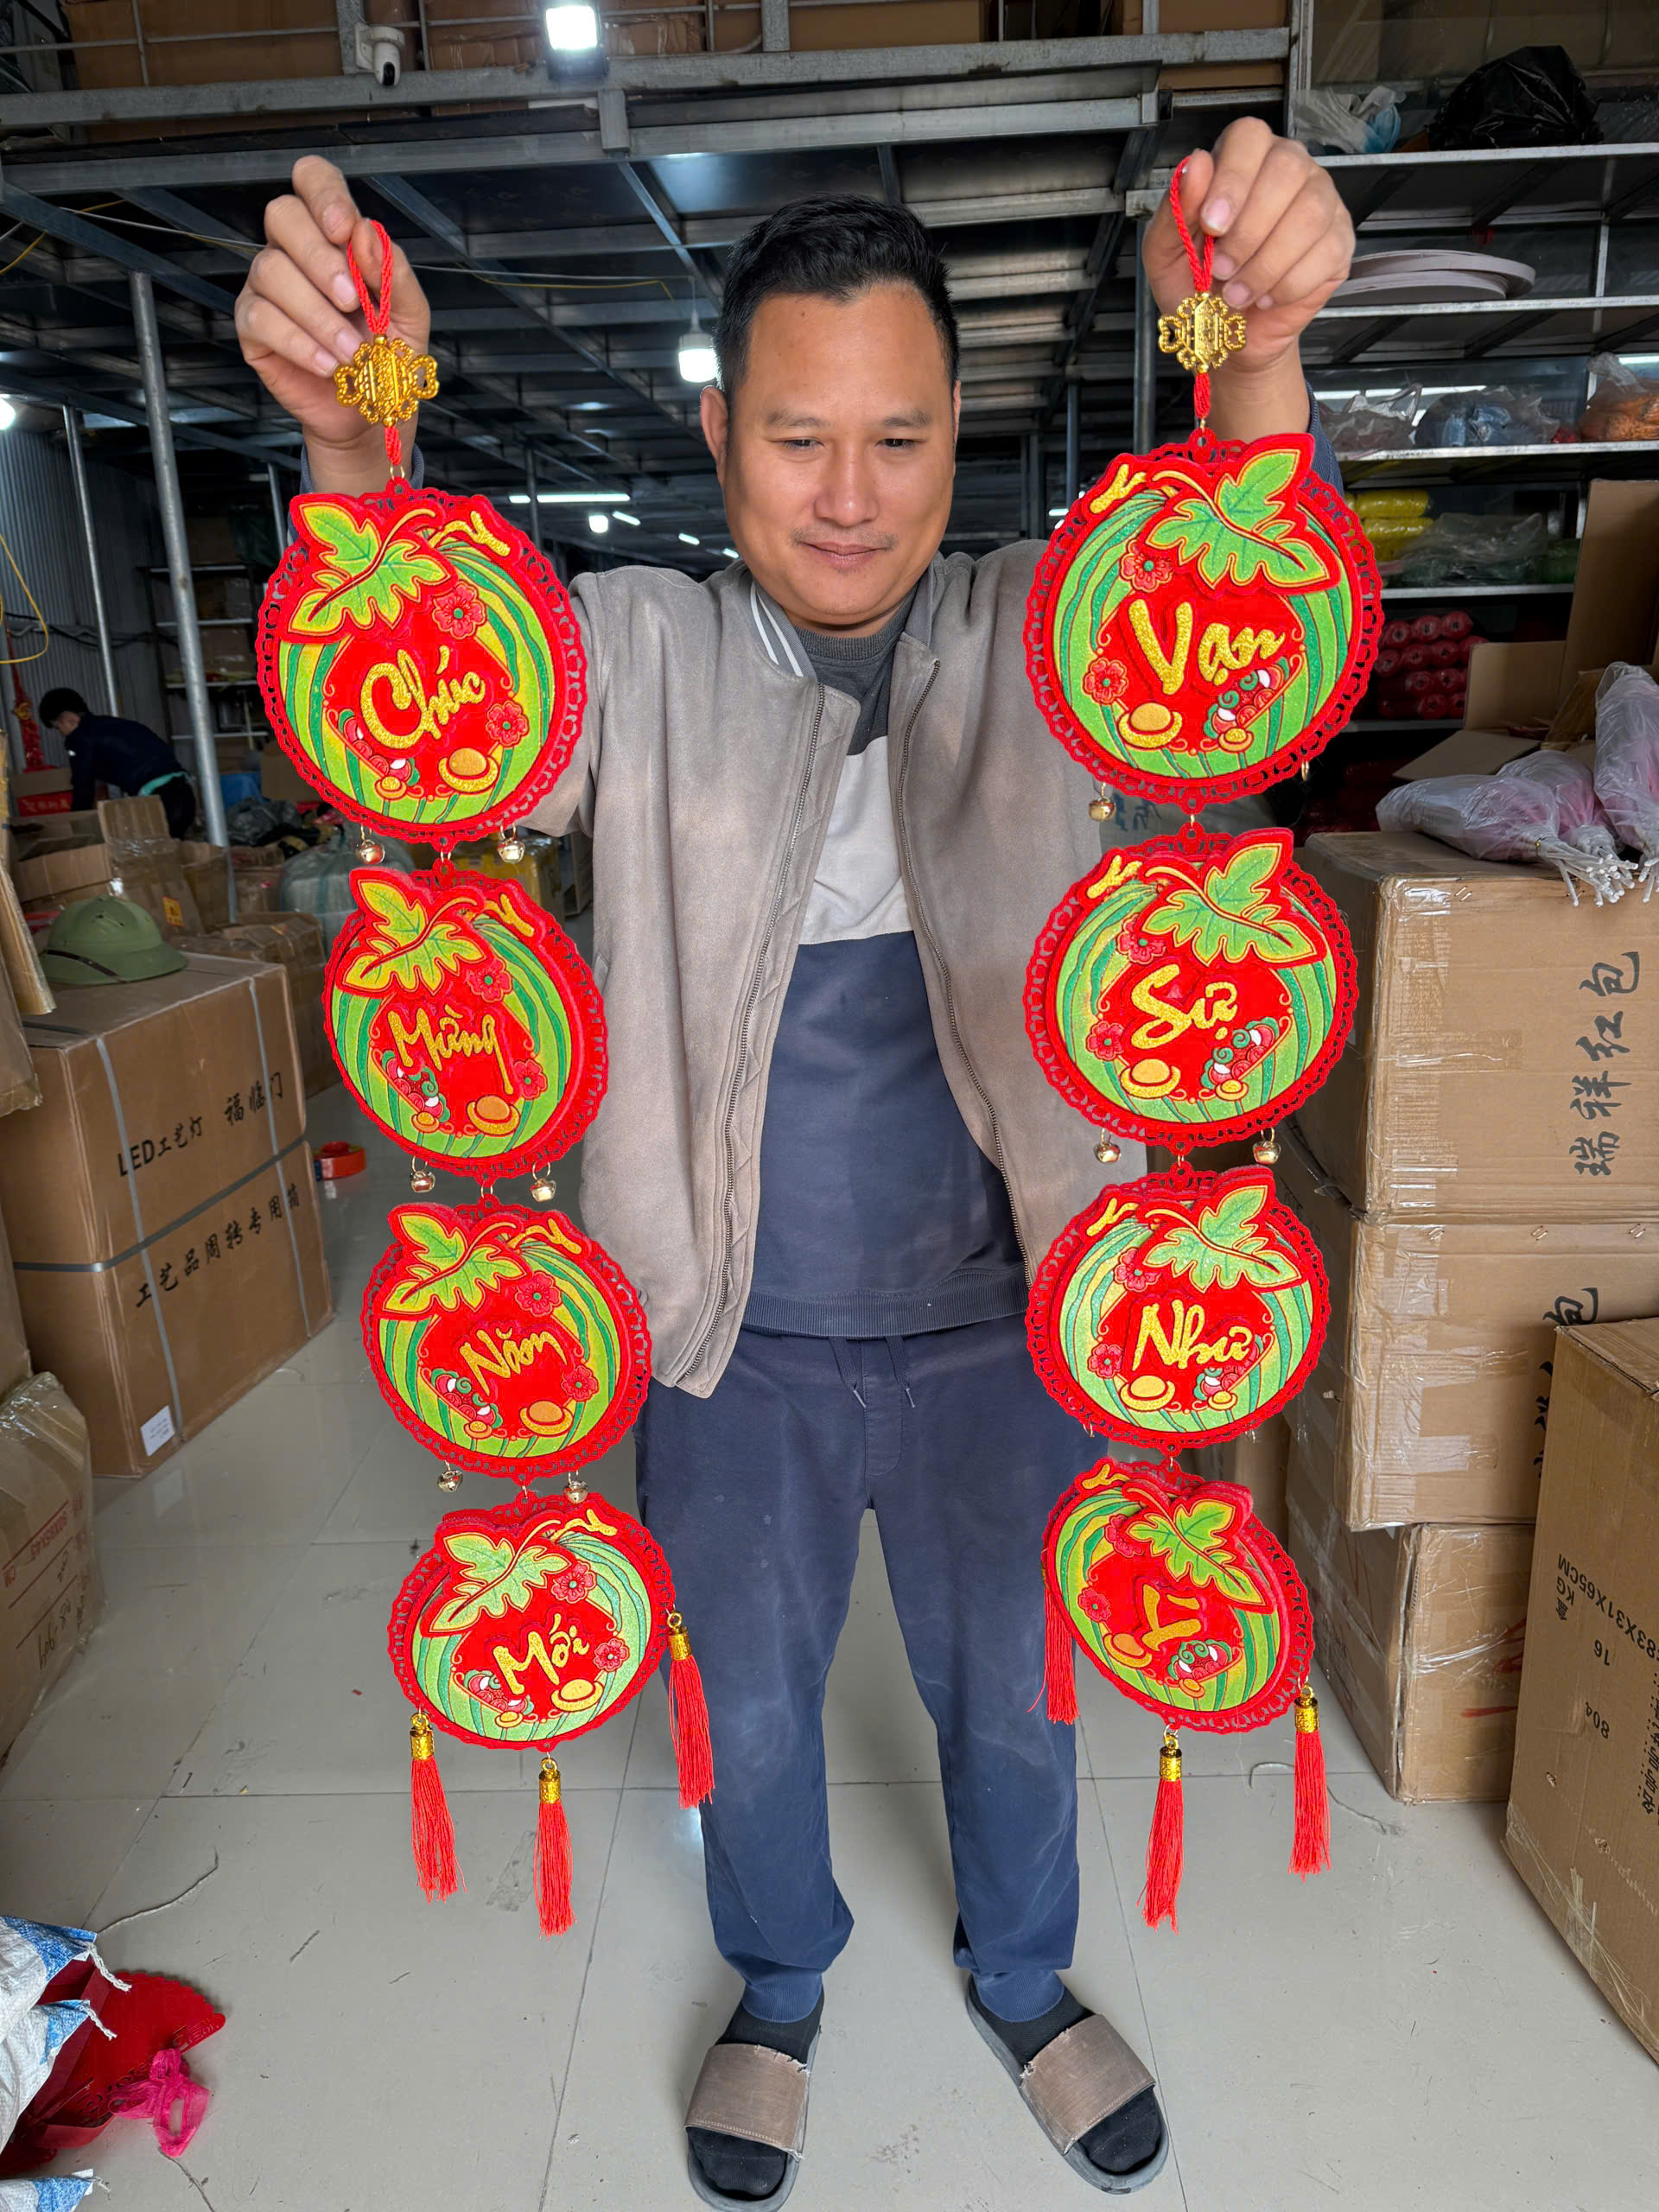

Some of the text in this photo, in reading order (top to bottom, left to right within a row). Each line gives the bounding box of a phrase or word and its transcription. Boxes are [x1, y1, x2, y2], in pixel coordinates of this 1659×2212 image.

[1128, 599, 1286, 696] Vạn
[360, 645, 486, 749] Chúc
[1130, 963, 1238, 1049] Sự
[387, 1004, 513, 1095] Mừng
[1569, 951, 1640, 1177] 瑞祥红包
[224, 1071, 283, 1126] 福临门
[136, 1183, 300, 1308] 工艺品周转专用箱
[459, 1327, 568, 1396] Năm
[1131, 1299, 1252, 1371] Như
[1555, 1577, 1574, 1605] KG
[493, 1613, 589, 1694] Mới
[1593, 1639, 1610, 1666] 16
[1585, 1701, 1610, 1739] 804
